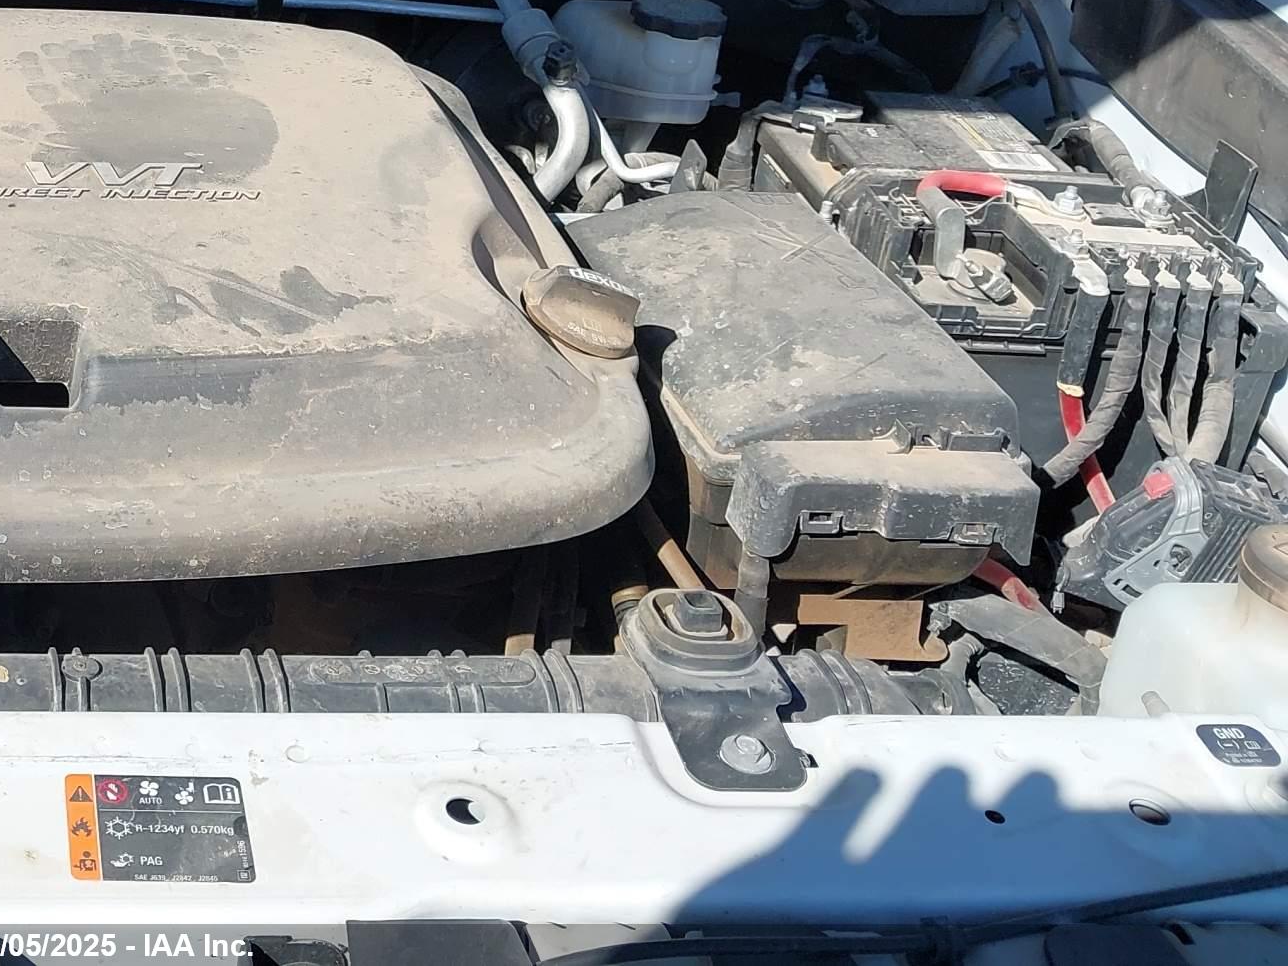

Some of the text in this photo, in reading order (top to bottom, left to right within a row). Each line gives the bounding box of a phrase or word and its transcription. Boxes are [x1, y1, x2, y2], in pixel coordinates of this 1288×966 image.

[25, 162, 204, 187] VVT
[100, 187, 262, 202] INJECTION
[1212, 728, 1246, 740] GND
[139, 797, 162, 805] AUTO
[135, 825, 235, 836] R-1234yf 0.570kg
[140, 856, 163, 866] PAG
